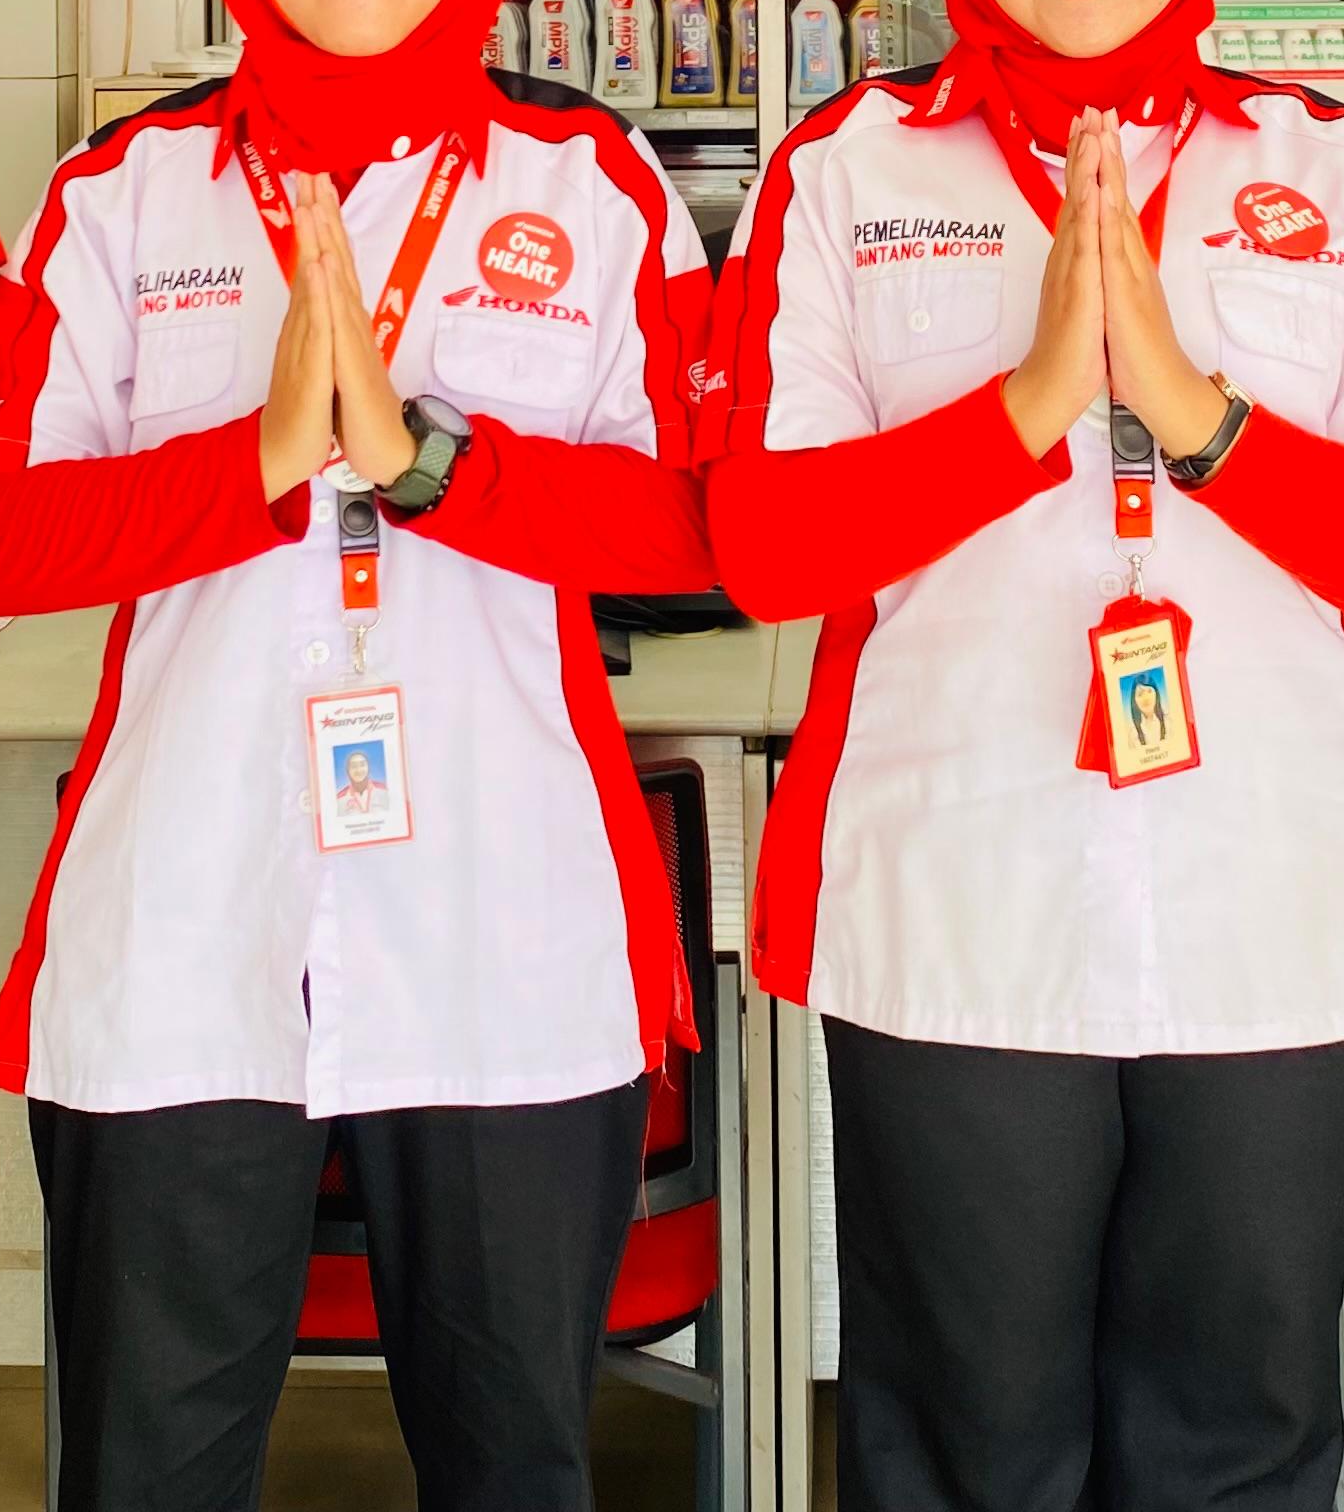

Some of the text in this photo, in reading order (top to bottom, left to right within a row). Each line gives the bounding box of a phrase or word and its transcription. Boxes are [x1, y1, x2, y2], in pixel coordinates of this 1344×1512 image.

[1253, 200, 1294, 222] One
[1256, 207, 1324, 244] HEART.
[508, 231, 552, 261] One
[854, 218, 1006, 246] PEMELIHARAAN
[484, 247, 560, 289] HEART.
[855, 241, 1004, 268] BINTANG MOTOR
[175, 289, 242, 309] MOTOR
[477, 294, 592, 327] HONDA
